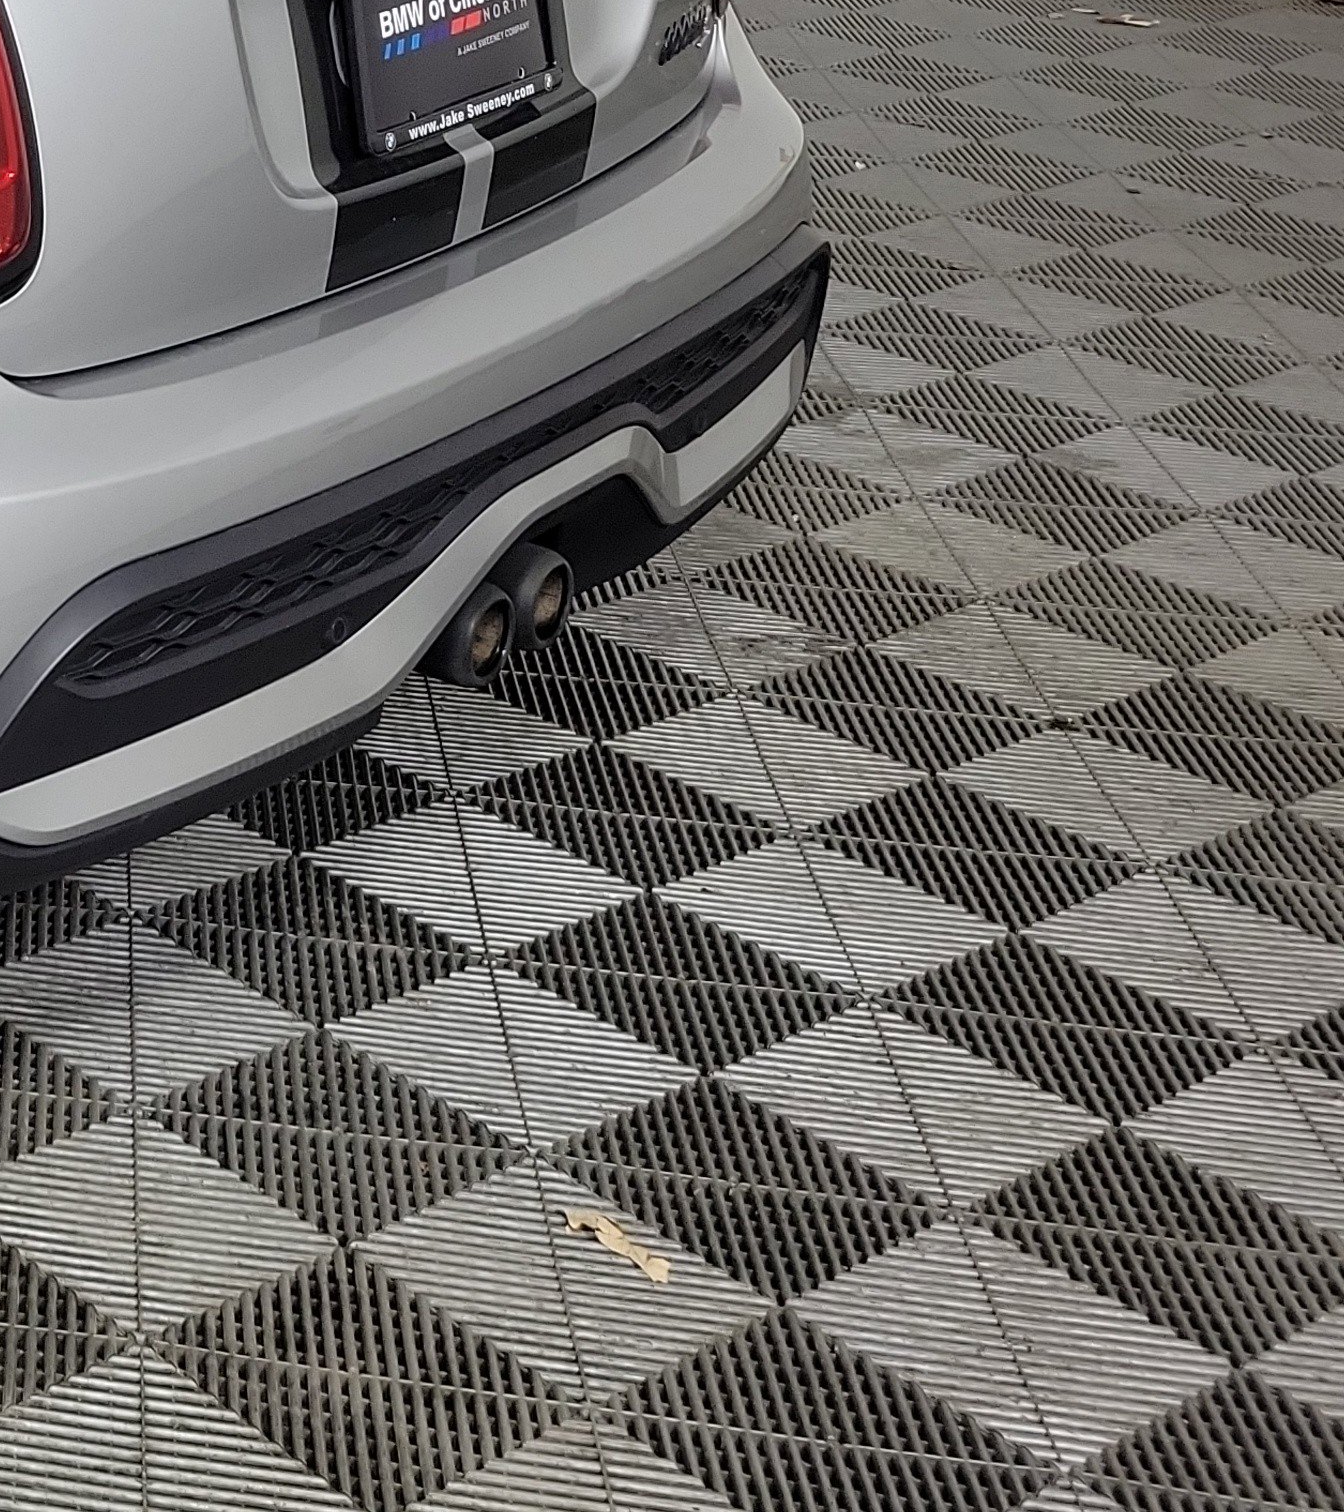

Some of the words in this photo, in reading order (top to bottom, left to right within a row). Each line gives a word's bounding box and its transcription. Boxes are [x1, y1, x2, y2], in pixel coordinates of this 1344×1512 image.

[463, 40, 478, 55] JAKE
[477, 30, 505, 49] SWEENEY
[504, 20, 530, 38] COMPANY
[408, 109, 465, 140] www.Jake
[466, 82, 536, 119] Sweeney.com
